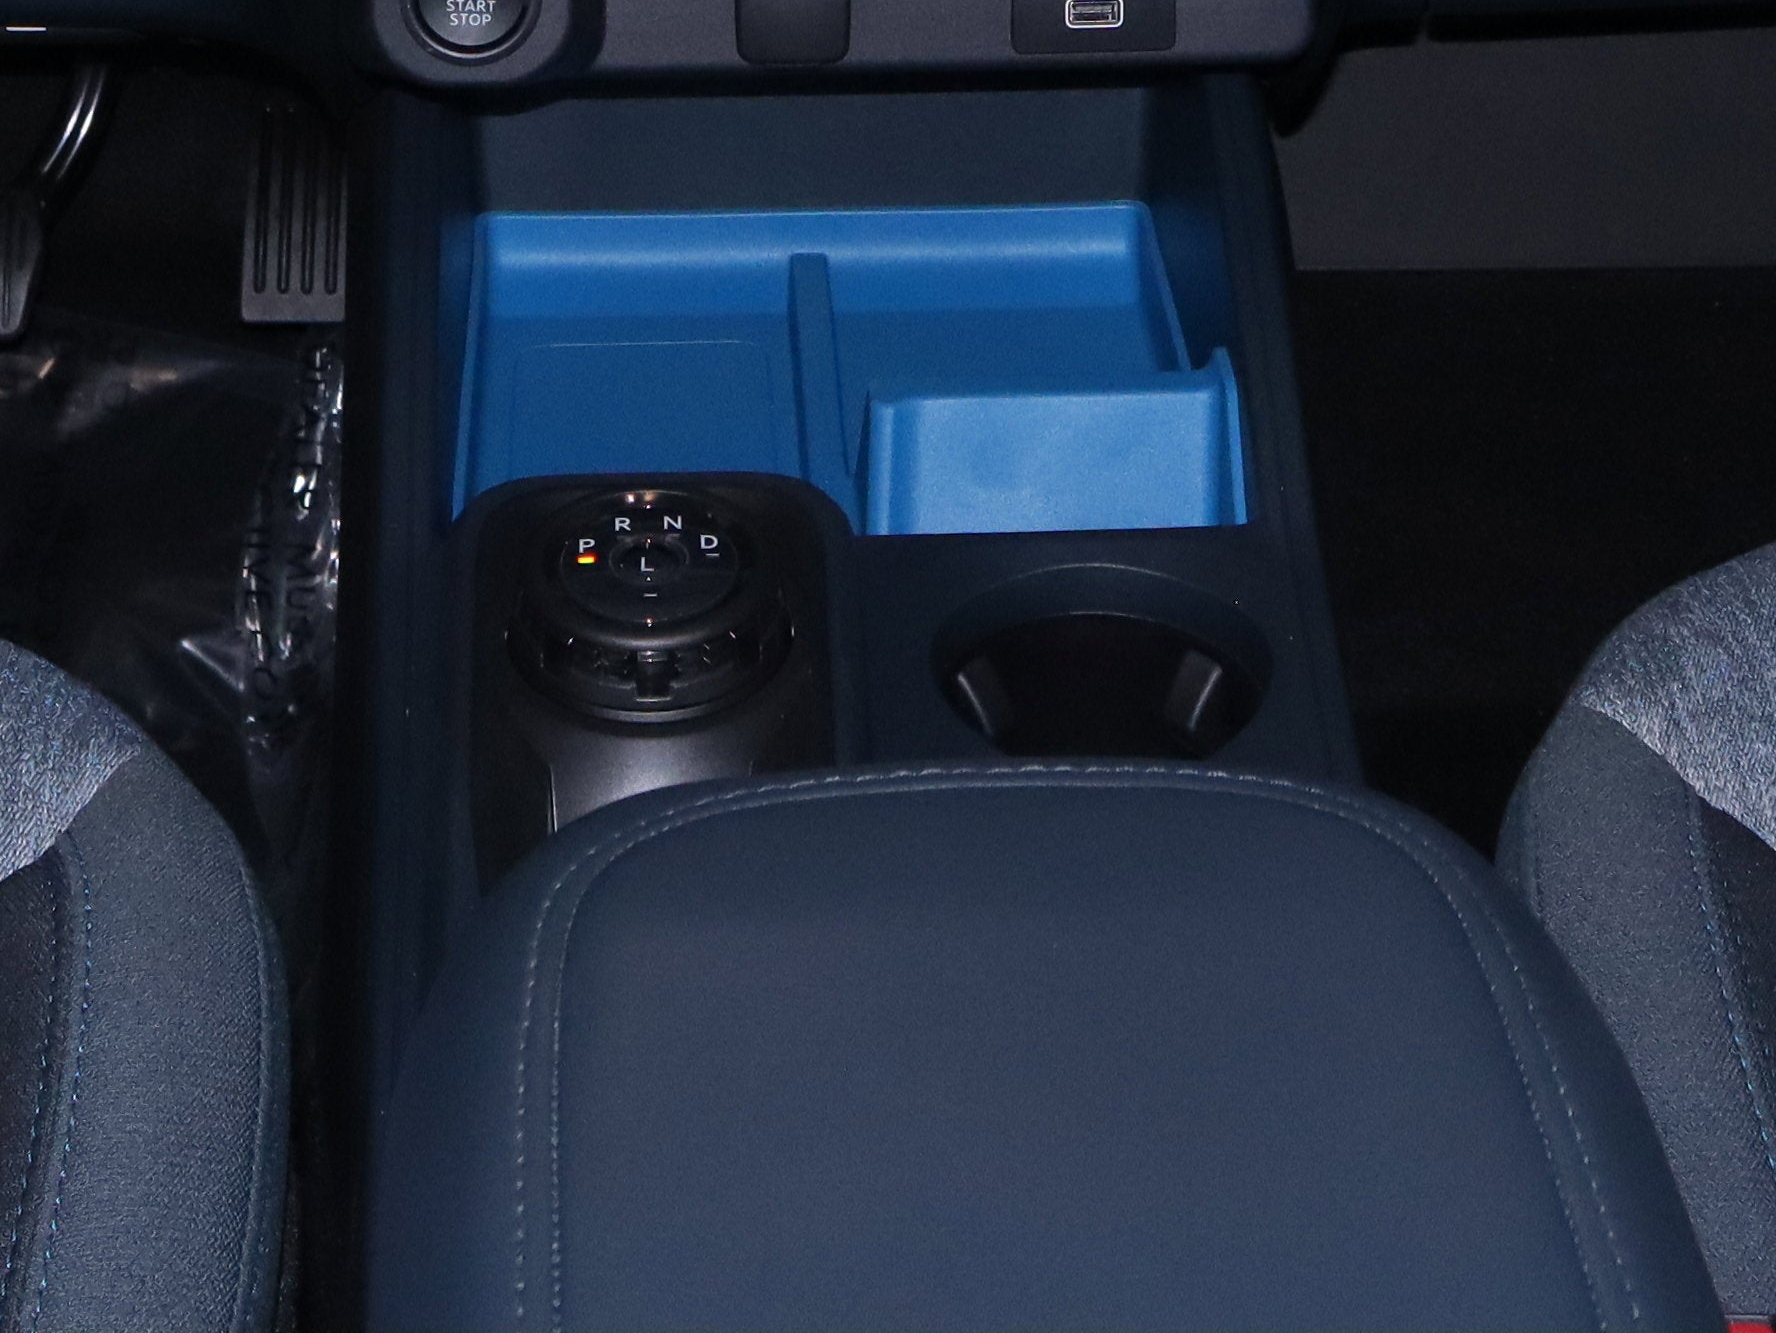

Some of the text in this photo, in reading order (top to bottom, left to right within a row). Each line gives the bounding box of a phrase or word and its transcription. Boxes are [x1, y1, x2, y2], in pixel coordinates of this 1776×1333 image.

[446, 0, 497, 13] START
[449, 13, 492, 26] STOP
[614, 515, 682, 532] R N
[579, 534, 719, 553] P D
[640, 556, 655, 572] L
